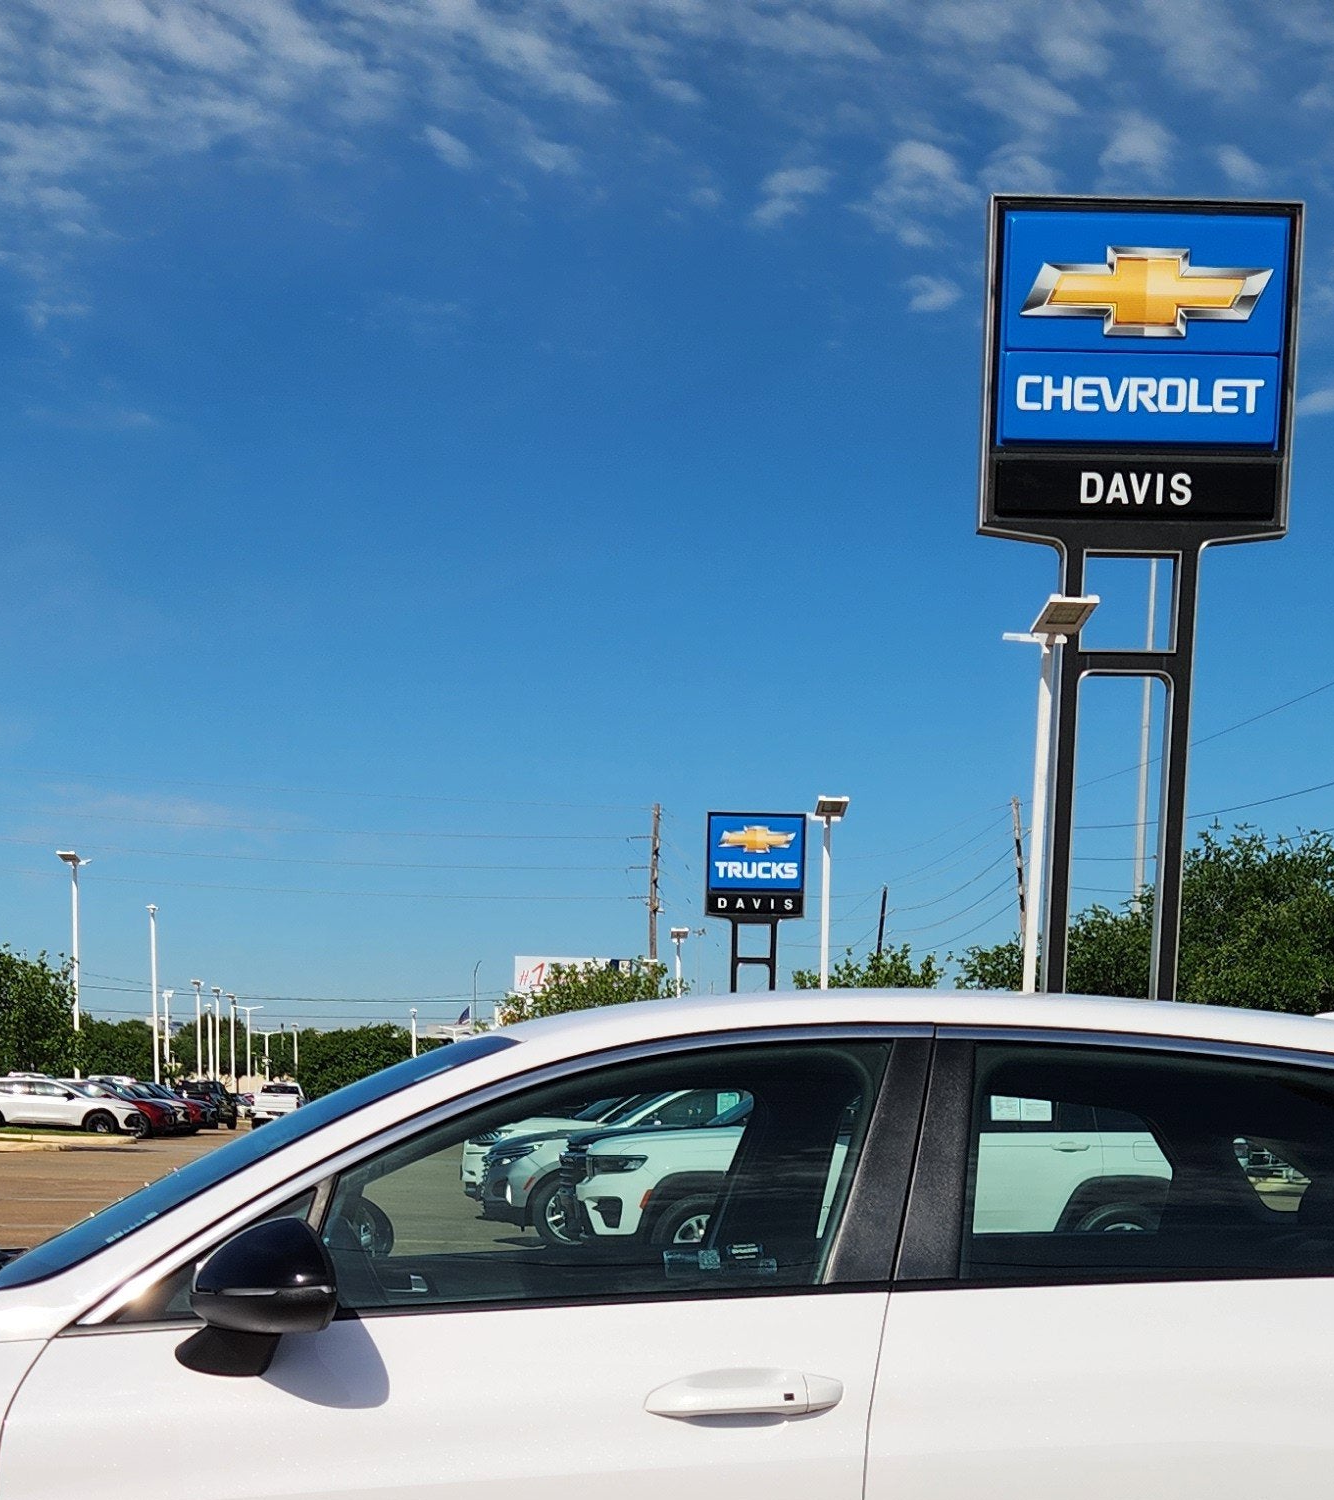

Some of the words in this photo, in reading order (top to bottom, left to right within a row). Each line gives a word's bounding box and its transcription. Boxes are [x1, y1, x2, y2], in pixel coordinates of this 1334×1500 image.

[1016, 375, 1265, 414] CHEVROLET
[1079, 471, 1193, 507] DAVIS
[714, 861, 798, 880] TRUCKS
[717, 897, 794, 911] DAVIS
